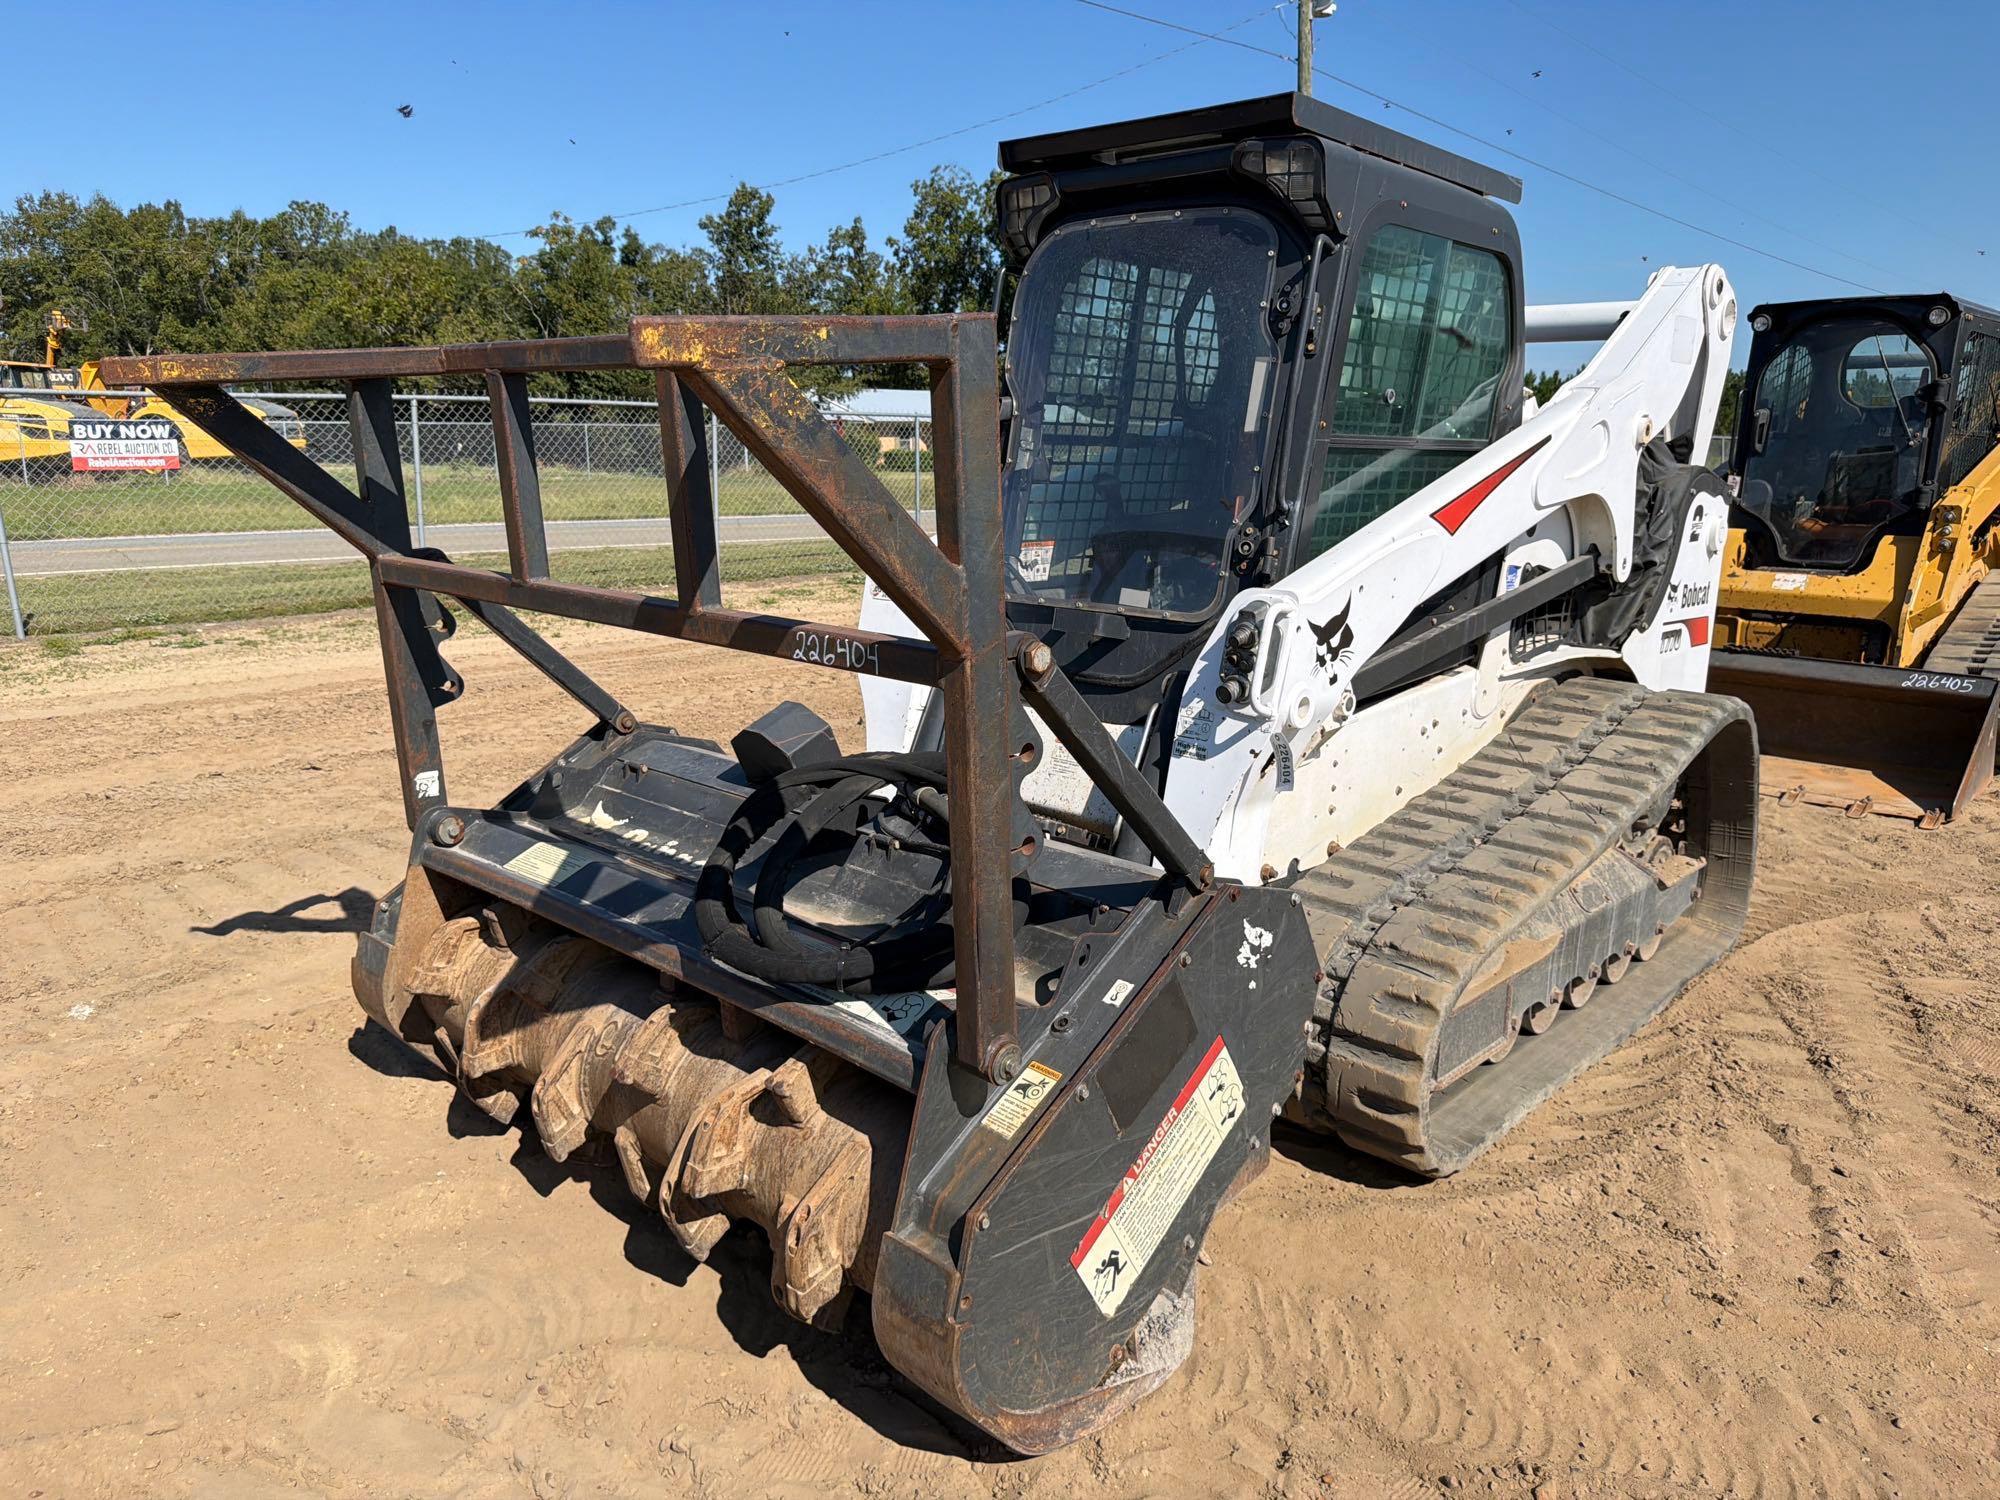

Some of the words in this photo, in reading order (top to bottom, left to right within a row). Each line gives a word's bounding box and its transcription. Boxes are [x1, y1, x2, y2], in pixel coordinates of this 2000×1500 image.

[73, 425, 114, 439] BUY
[120, 424, 170, 439] NOW
[97, 443, 123, 455] REBEL
[125, 442, 160, 454] AUCTION
[163, 441, 176, 454] CO.
[87, 458, 166, 468] RebelAuction.com
[1681, 581, 1710, 608] Bobcat
[793, 631, 879, 675] 226404
[1901, 673, 1976, 693] 226405
[1279, 743, 1291, 784] 226404
[1035, 1064, 1060, 1079] WARNING
[1132, 1107, 1178, 1175] DANGER
[1113, 1189, 1134, 1221] THROWN
[1132, 1158, 1154, 1191] OBJECTS
[1160, 1116, 1182, 1150] ROTATING
[1115, 1209, 1127, 1226] CAN
[1125, 1185, 1142, 1211] CAUSE
[1160, 1133, 1177, 1158] INJURY
[1182, 1101, 1198, 1123] DEATH
